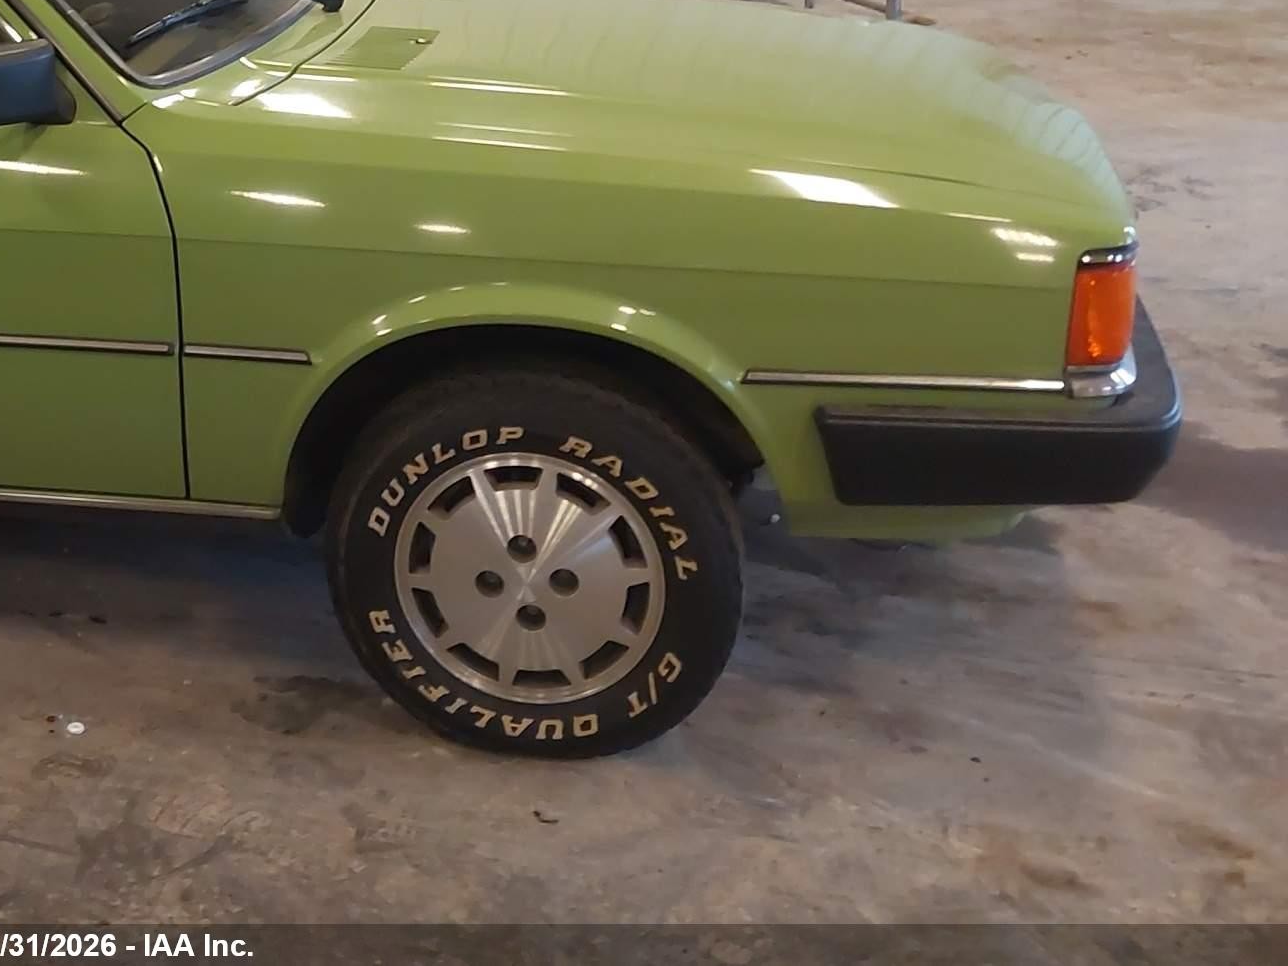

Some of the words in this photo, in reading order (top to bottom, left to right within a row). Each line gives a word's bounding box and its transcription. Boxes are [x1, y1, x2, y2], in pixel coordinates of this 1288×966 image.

[368, 426, 525, 537] DUNLOP
[559, 436, 698, 580] RADIAL
[369, 610, 599, 740] QUALIFIER
